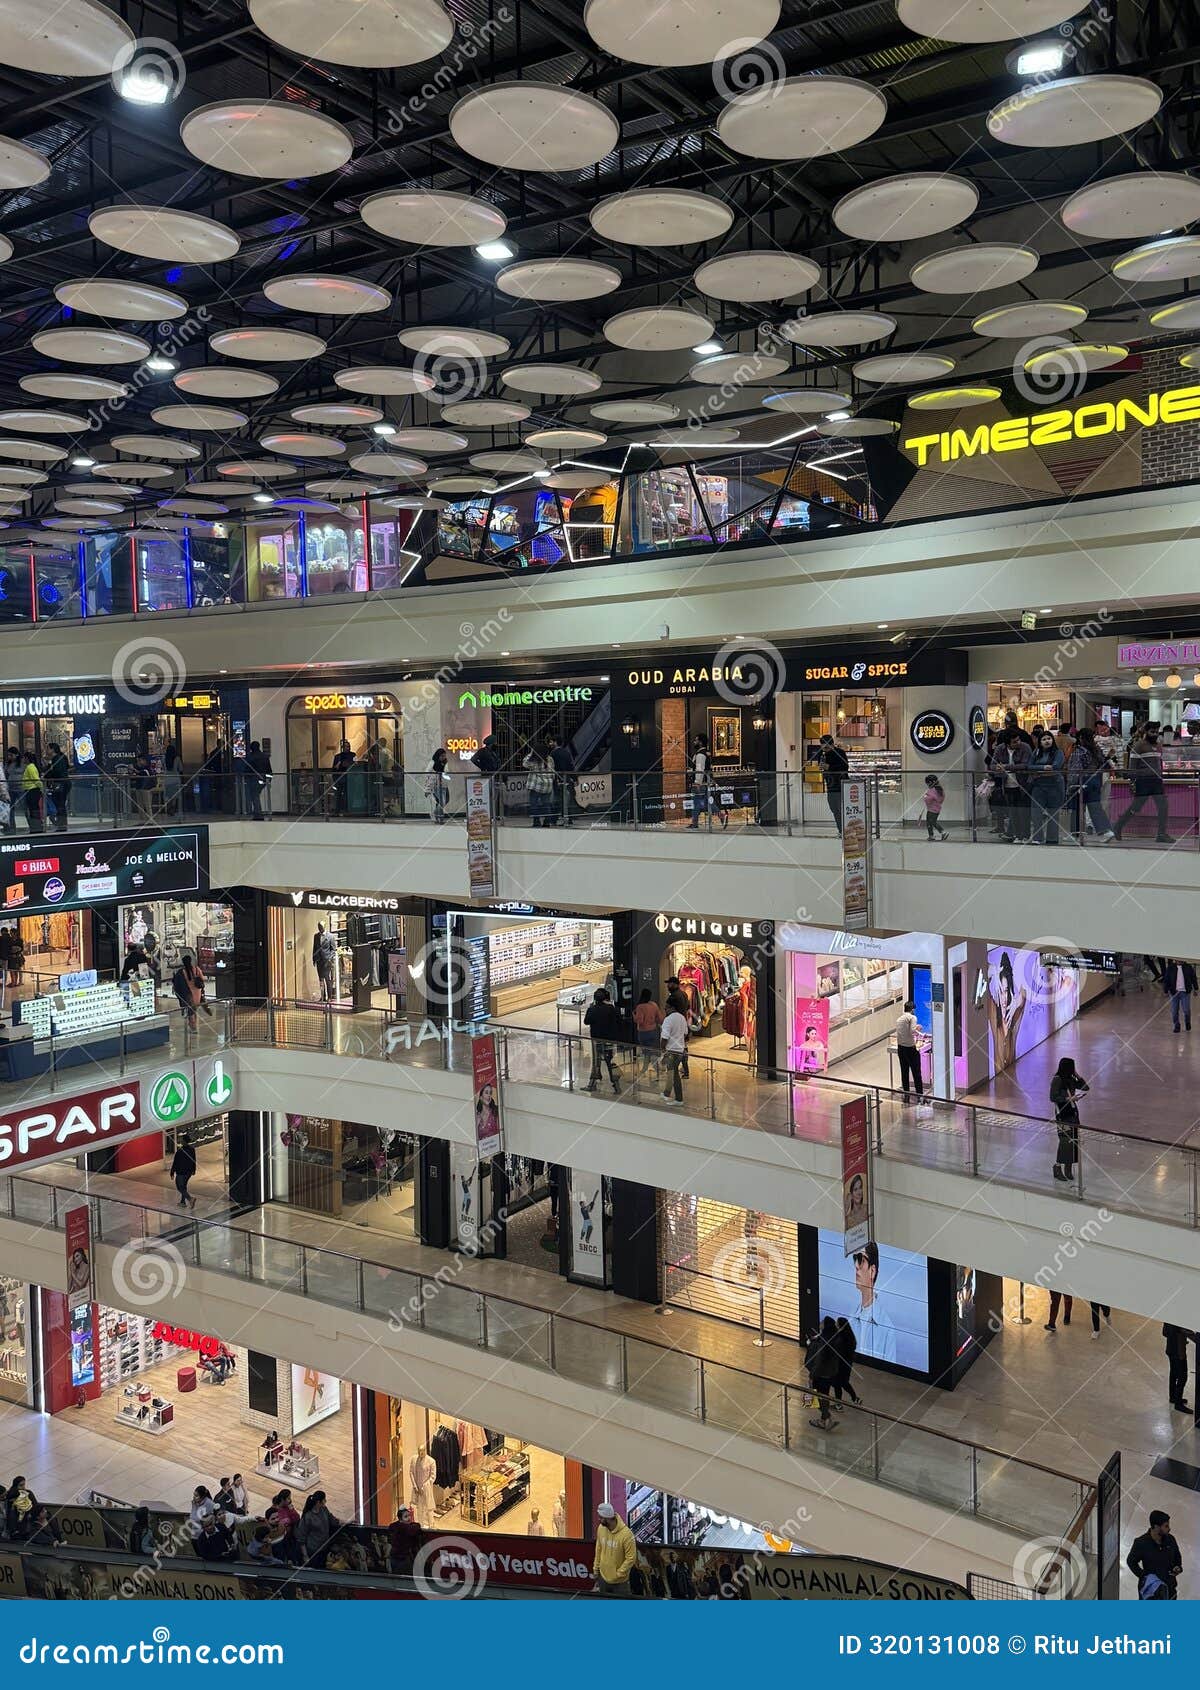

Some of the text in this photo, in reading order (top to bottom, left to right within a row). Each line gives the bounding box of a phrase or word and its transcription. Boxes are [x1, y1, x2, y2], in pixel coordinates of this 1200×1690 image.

[906, 386, 1200, 466] TIMEZONE
[628, 666, 743, 685] OUD ARABIA
[805, 662, 908, 681] SUGAR & SPICE
[480, 686, 593, 707] homecentre
[669, 686, 696, 694] DUBAI
[28, 695, 66, 716] COFFEE
[69, 694, 107, 715] HOUSE
[305, 692, 374, 714] spezia bistro
[580, 780, 605, 793] LOOKS
[1, 843, 31, 853] BRANDS
[125, 850, 193, 866] JOE & MELLON
[29, 861, 53, 872] BIBA
[308, 893, 399, 910] BLACKBERRYS
[829, 930, 858, 953] Mia
[440, 1550, 471, 1571] End
[473, 1550, 497, 1573] Of
[500, 1554, 544, 1577] Year
[111, 1574, 235, 1600] MOHANLAL SONS
[755, 1568, 884, 1596] MOHANLAL
